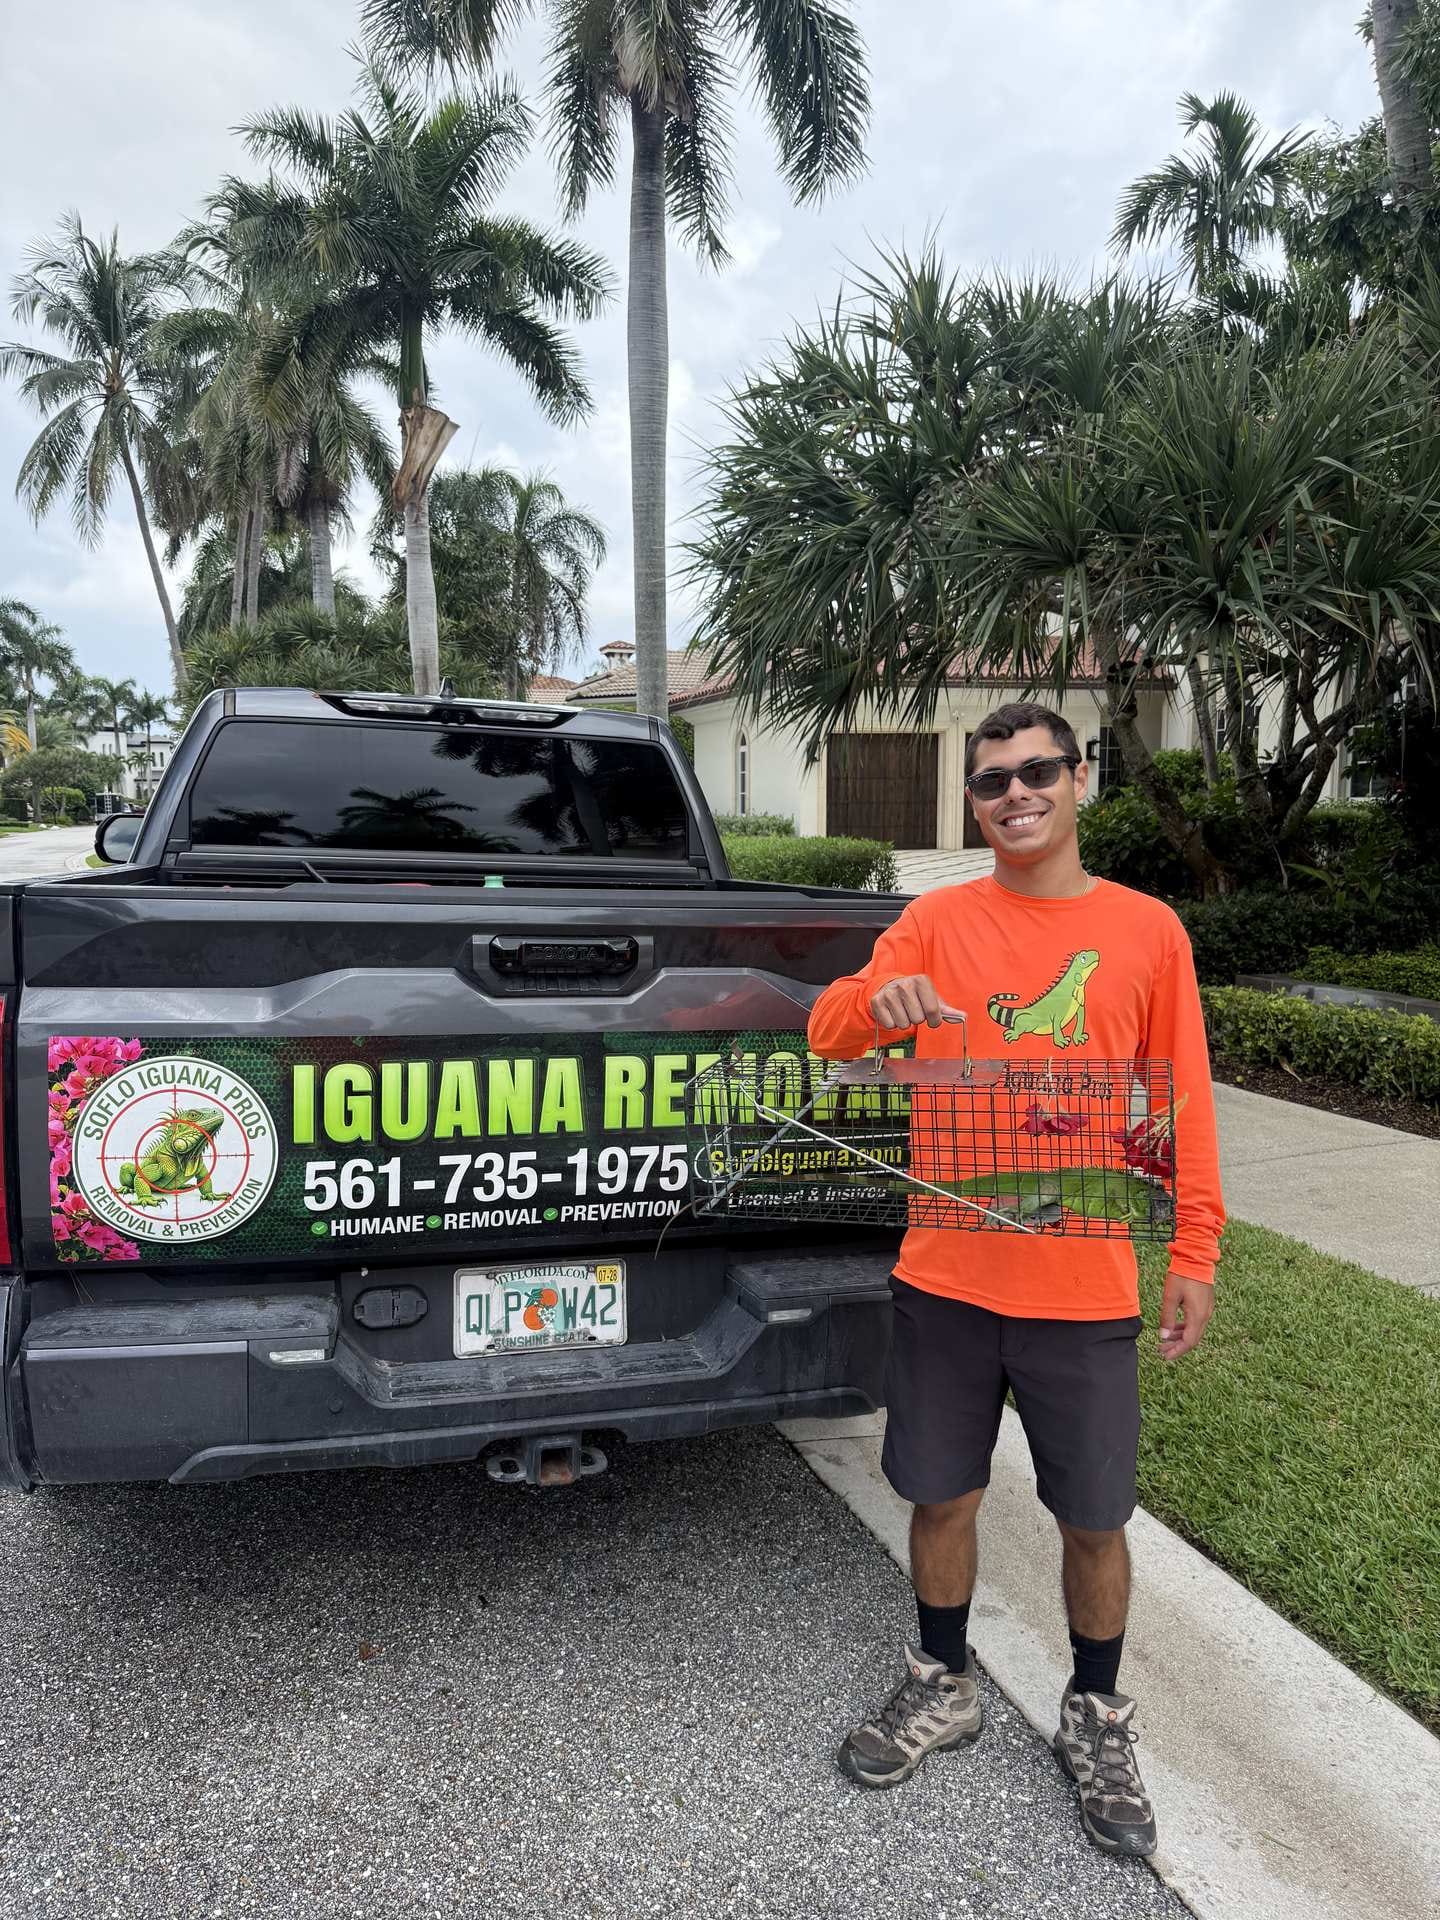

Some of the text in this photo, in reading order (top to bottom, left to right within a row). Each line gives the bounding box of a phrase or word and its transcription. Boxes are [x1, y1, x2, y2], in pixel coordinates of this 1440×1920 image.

[83, 1064, 267, 1141] SOFLO IGUANA PROS
[293, 1057, 586, 1144] IGUANA
[303, 1144, 689, 1212] 561-735-1975
[807, 1187, 819, 1202] &
[89, 1177, 264, 1238] REMOVAL & PREVENTION
[330, 1200, 681, 1237] HUMANE REMOVAL PREVENTION
[494, 1264, 589, 1286] MYFLORIDA.COM
[465, 1283, 618, 1336] QLP W42
[494, 1333, 549, 1350] SUNSHINE
